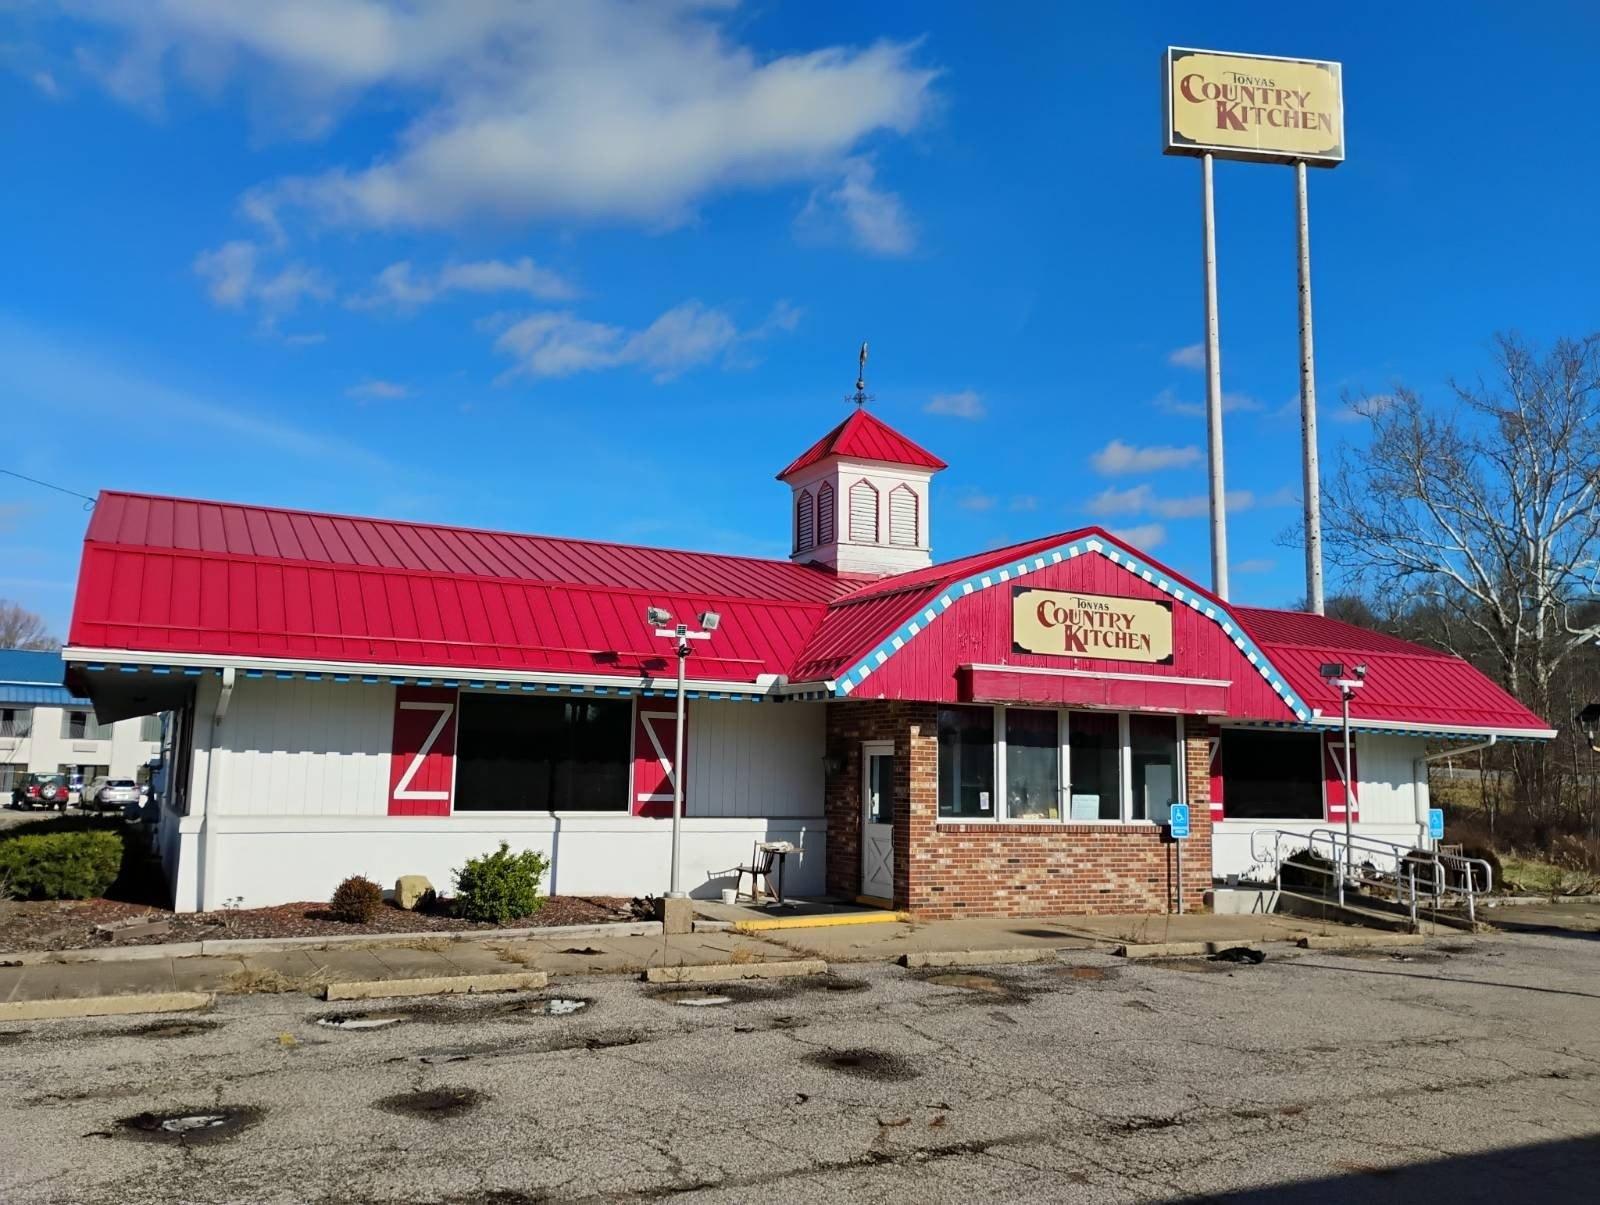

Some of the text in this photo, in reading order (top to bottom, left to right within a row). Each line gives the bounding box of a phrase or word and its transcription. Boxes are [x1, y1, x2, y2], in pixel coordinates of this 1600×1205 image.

[1180, 74, 1311, 109] COUNTRY
[1224, 71, 1275, 87] TONYAS
[1216, 100, 1332, 134] KITCHEN
[1037, 600, 1136, 631] COUNTRY
[1071, 597, 1110, 610] TONYAS
[1064, 625, 1151, 654] KITCHEN
